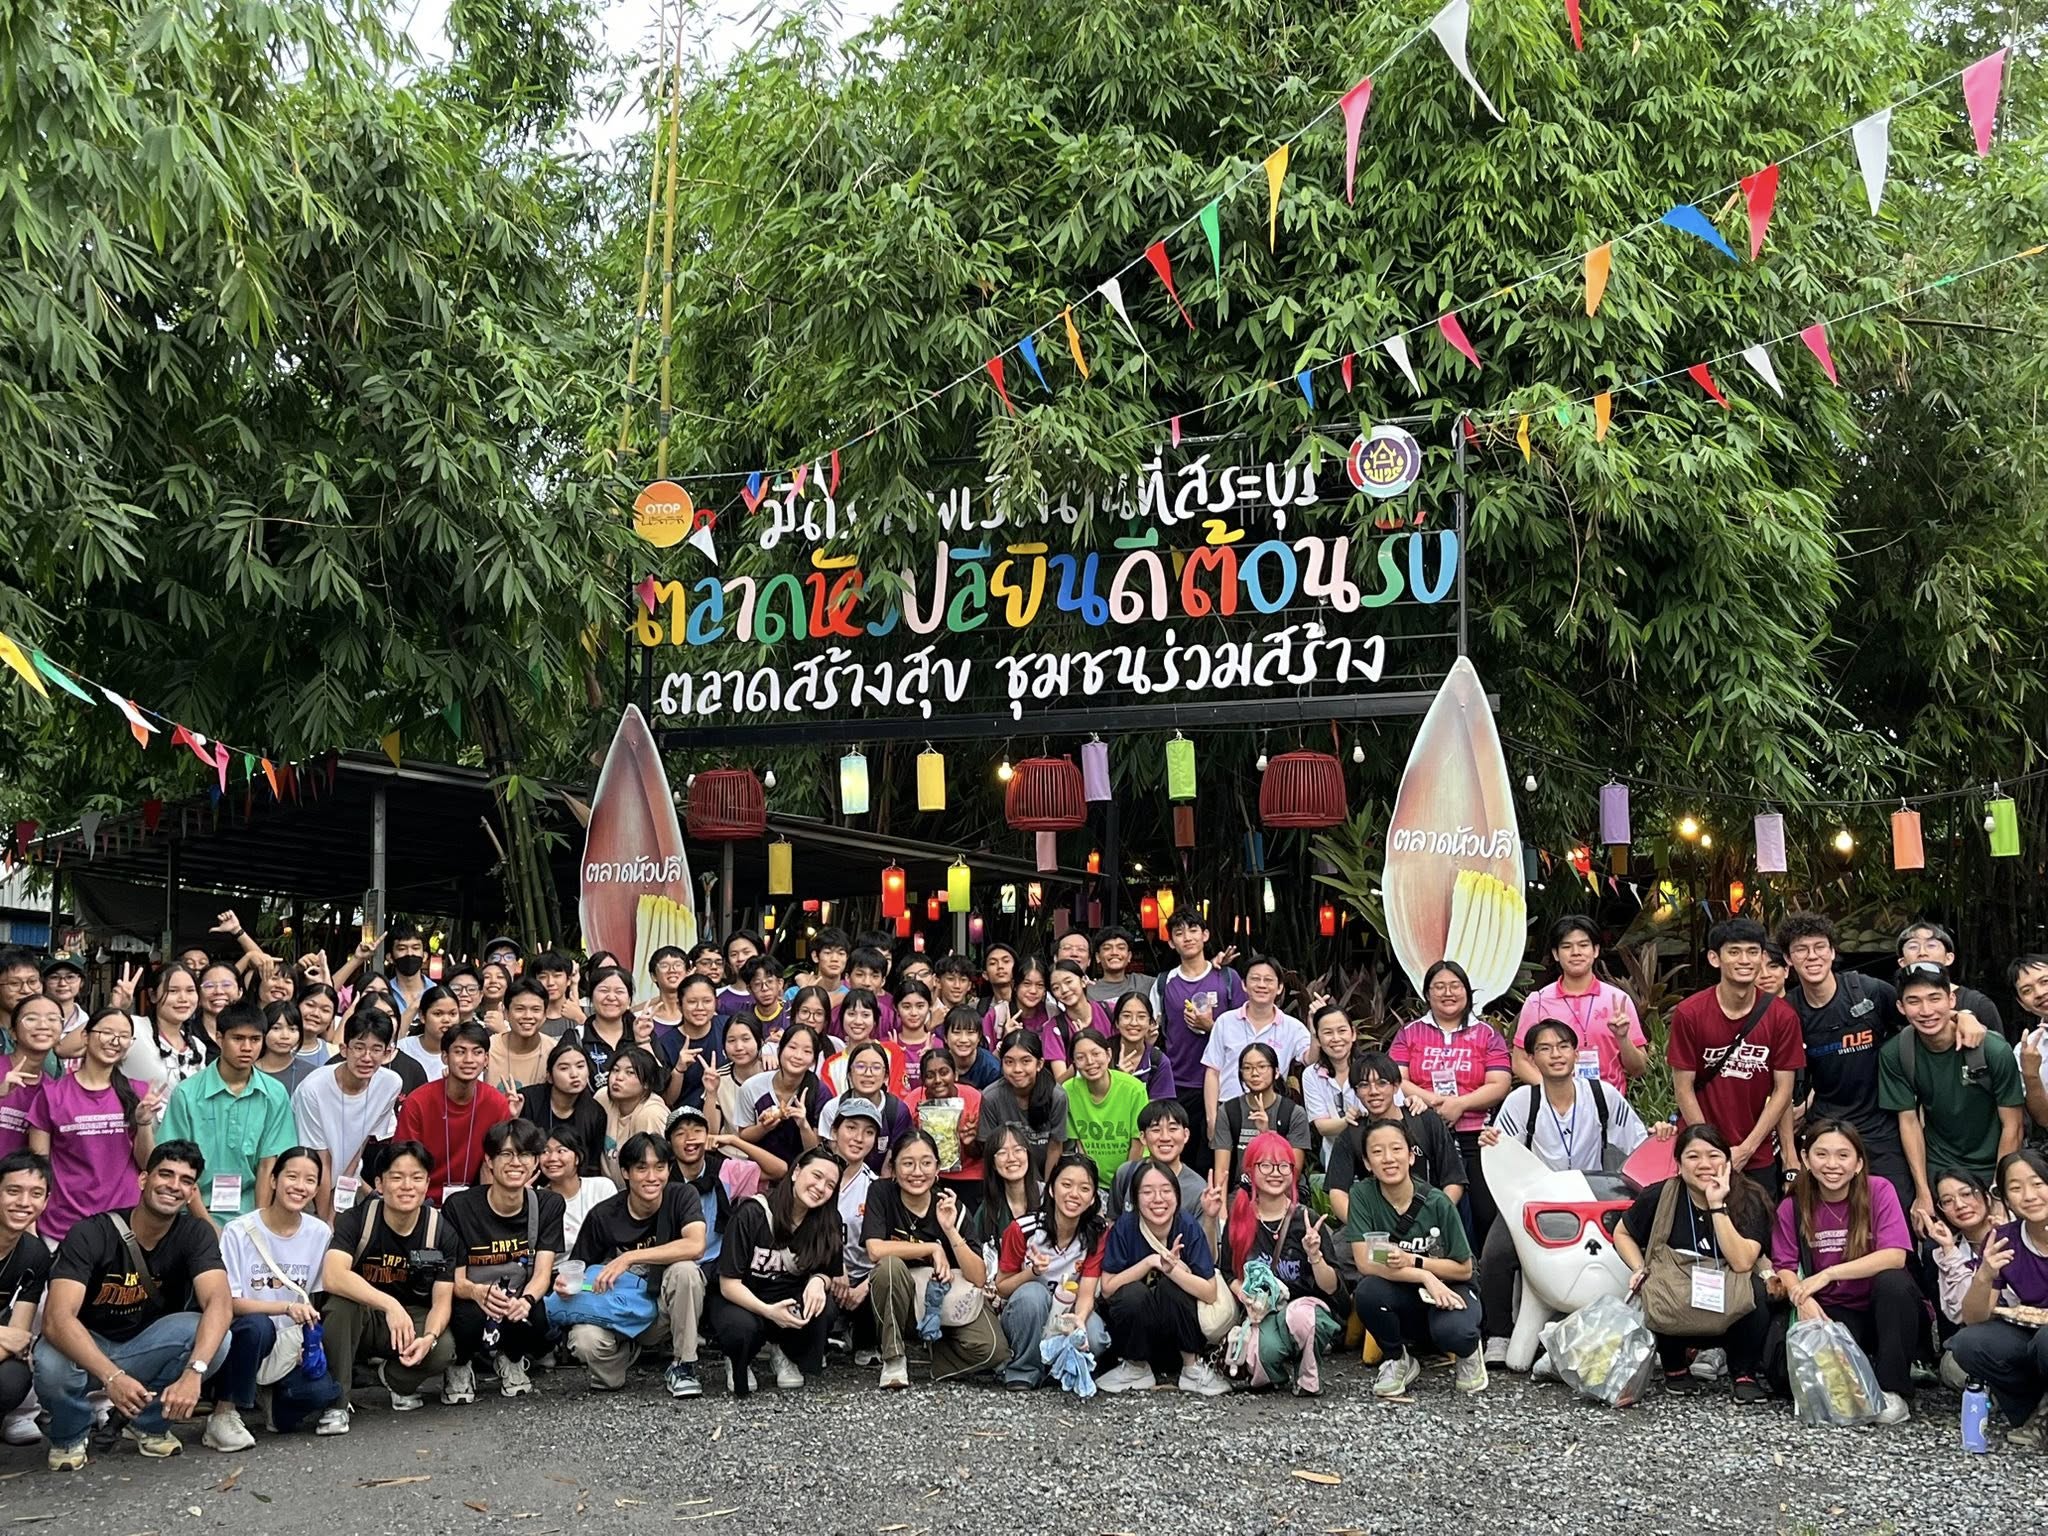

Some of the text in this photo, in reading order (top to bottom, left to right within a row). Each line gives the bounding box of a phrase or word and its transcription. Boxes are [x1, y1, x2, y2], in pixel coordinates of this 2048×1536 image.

[645, 503, 681, 515] OTOP
[655, 621, 1386, 721] ตลาดสร้างสุข ชุมชนร่วมสร้าง
[1393, 825, 1515, 859] ตลาดหัวปลี
[586, 855, 684, 883] ตลาดหัวปลี
[1424, 1046, 1472, 1057] team
[1421, 1055, 1472, 1072] chula
[1076, 1119, 1128, 1140] 2024
[491, 1238, 518, 1253] CAPT
